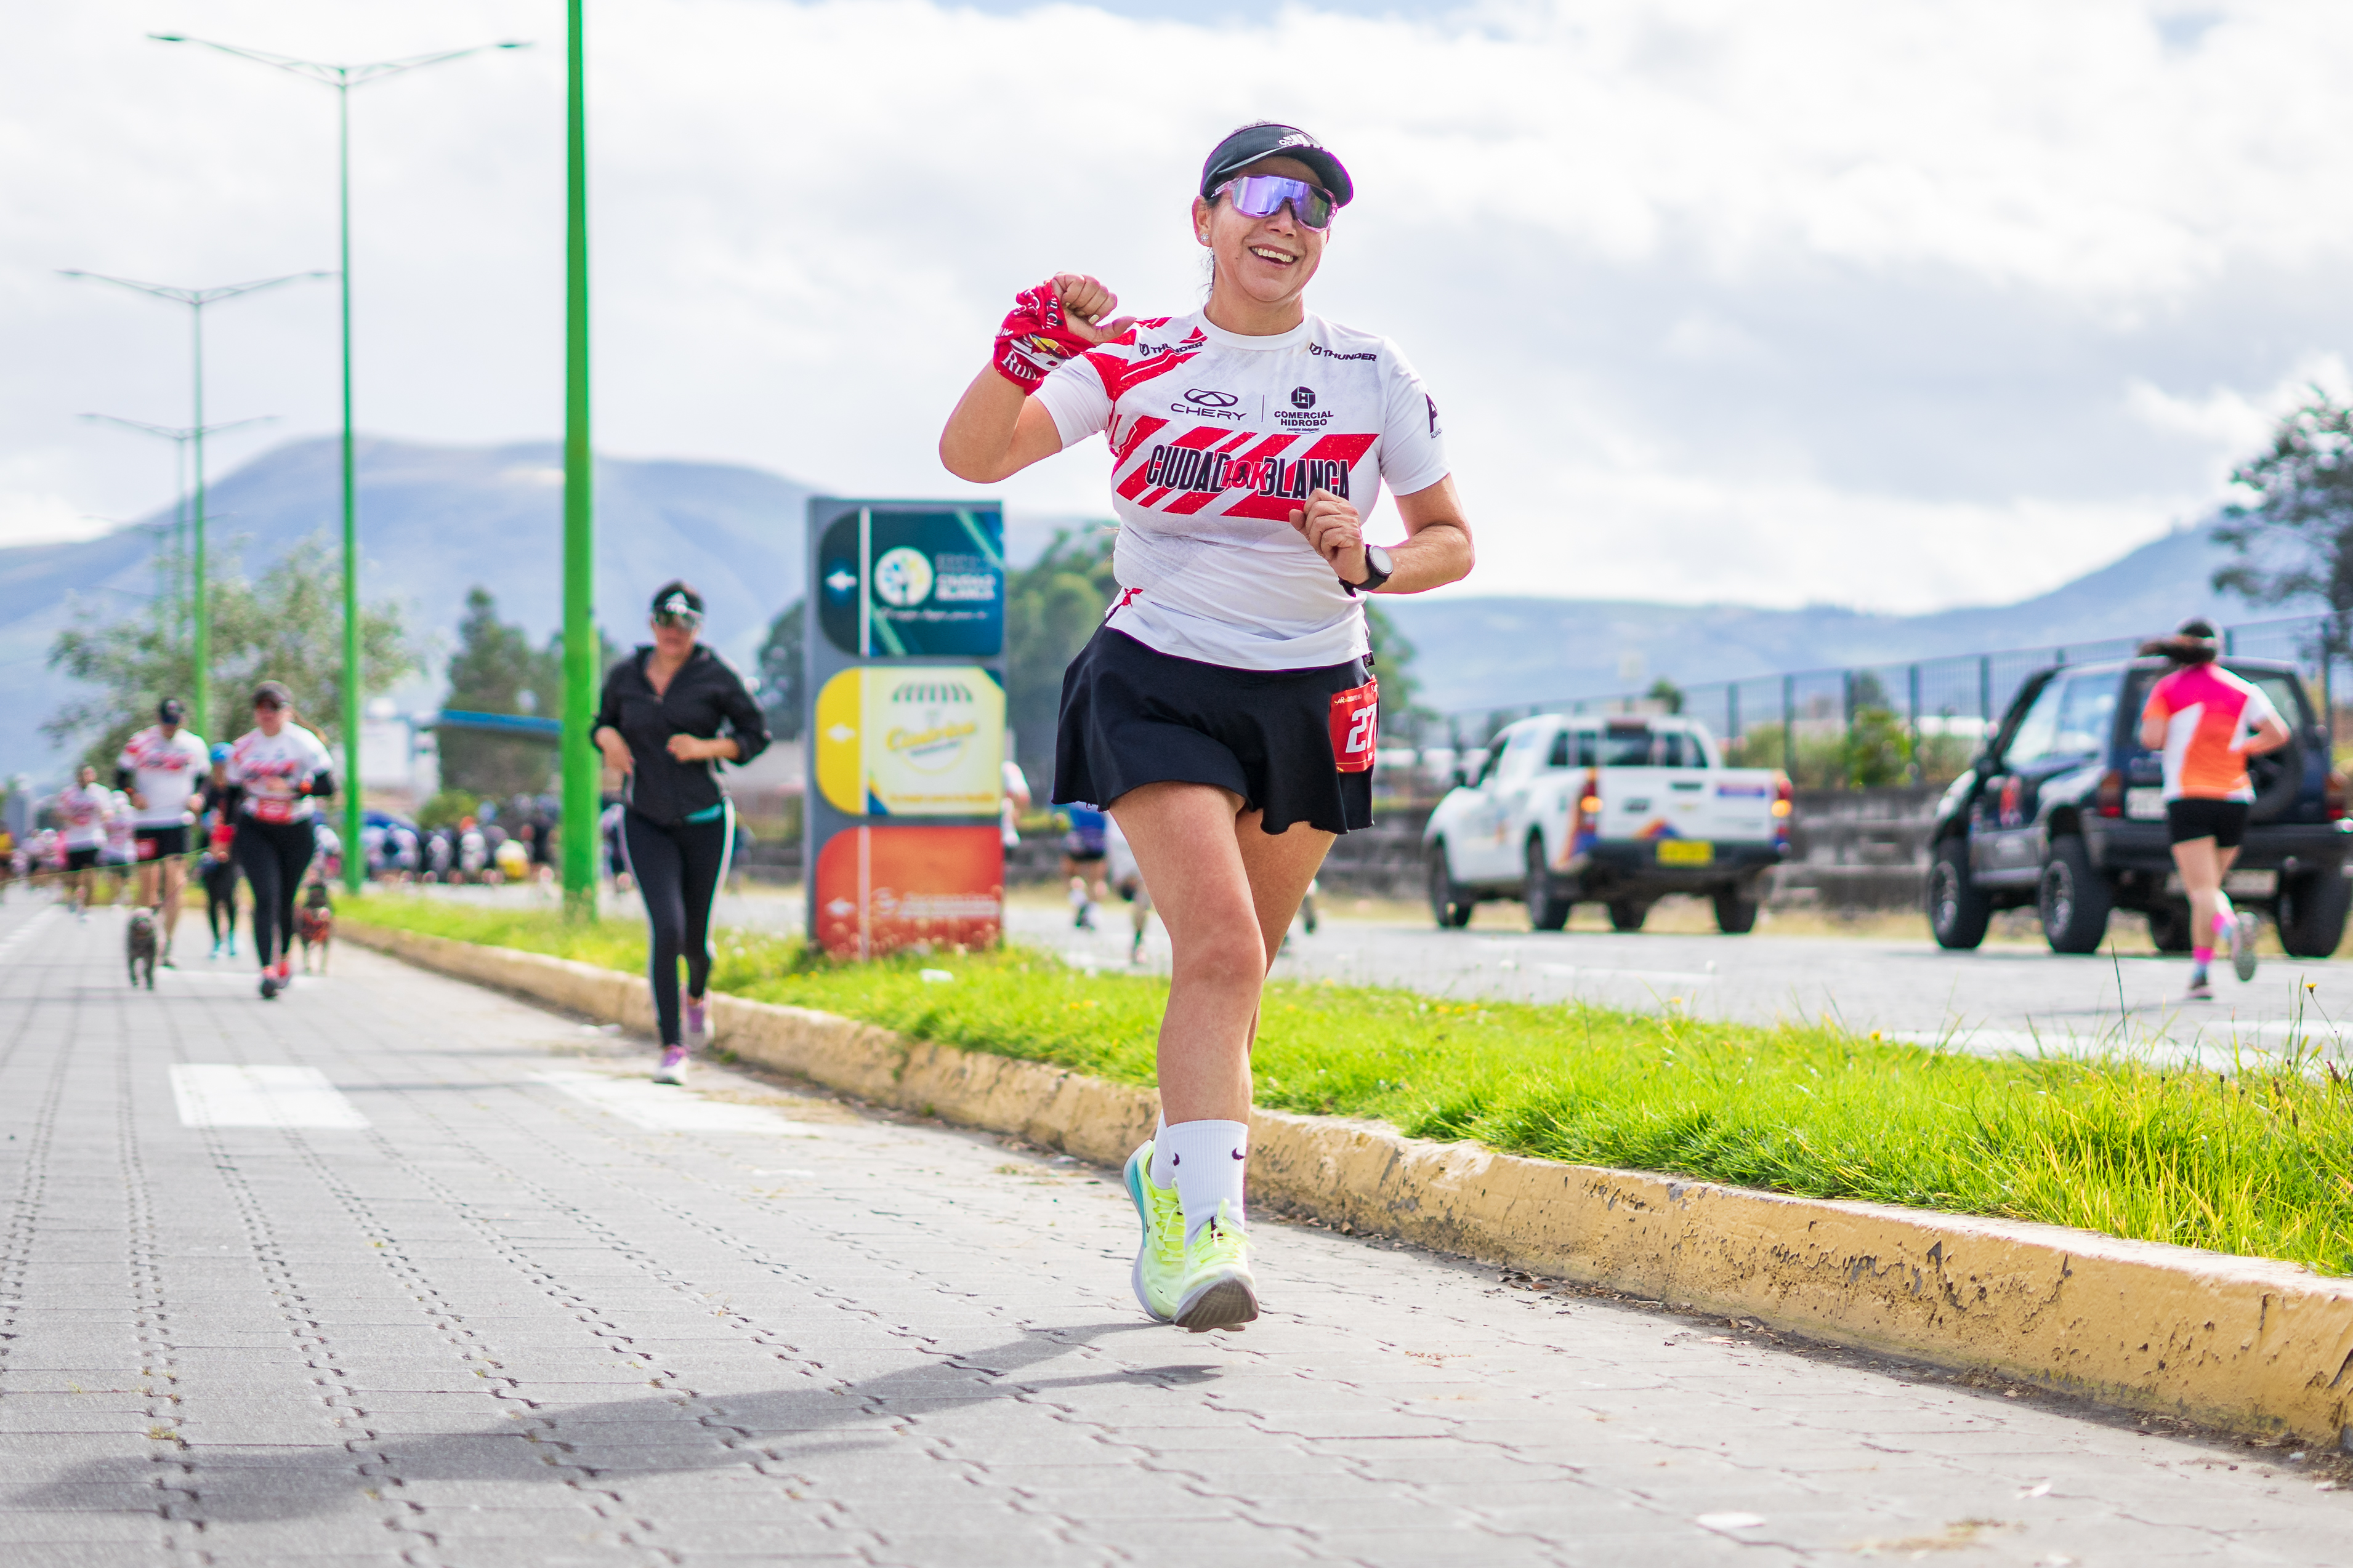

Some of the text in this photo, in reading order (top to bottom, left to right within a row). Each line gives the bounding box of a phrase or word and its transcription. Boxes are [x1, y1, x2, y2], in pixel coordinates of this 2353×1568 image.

[1323, 349, 1377, 362] THUNDER
[1170, 403, 1247, 421] CHERY
[1274, 410, 1334, 419] COMERCIAL
[1280, 418, 1327, 427] HIDROBO
[1145, 444, 1232, 494] CIUDAD
[1259, 456, 1350, 502] BLANCA
[1345, 702, 1378, 753] 27
